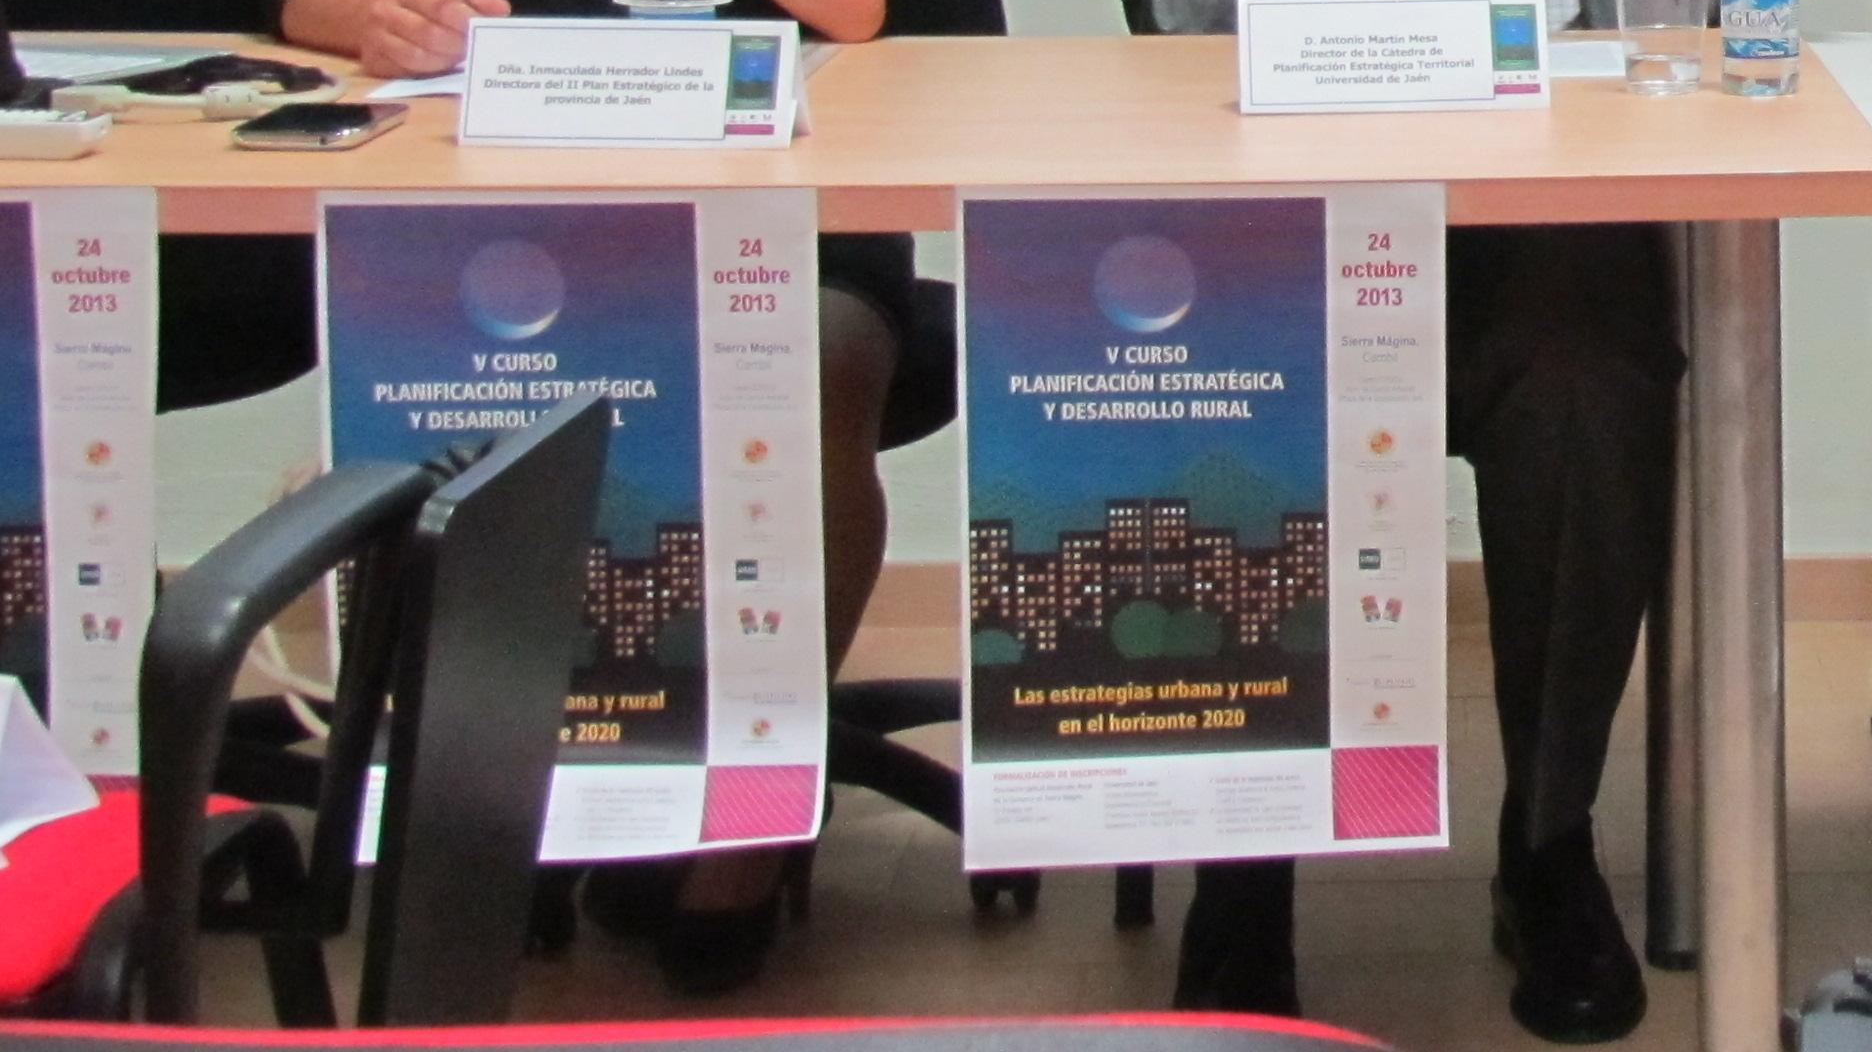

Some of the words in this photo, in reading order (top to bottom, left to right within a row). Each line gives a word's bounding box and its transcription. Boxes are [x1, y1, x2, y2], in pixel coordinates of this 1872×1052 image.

[1304, 37, 1316, 46] D.
[1320, 36, 1364, 45] Antonio
[1409, 35, 1438, 43] Mesa
[1301, 49, 1347, 59] Director
[1351, 49, 1364, 58] de
[1368, 49, 1378, 57] la
[1430, 47, 1443, 56] de
[498, 64, 526, 75] Dña.
[530, 65, 602, 76] Inmaculada
[606, 67, 660, 76] Herrador
[664, 67, 703, 77] Lindes
[1273, 62, 1346, 72] Planificación
[1417, 59, 1475, 69] Territorial
[484, 79, 541, 89] Directora
[544, 80, 563, 90] del
[567, 80, 578, 90] II
[583, 80, 609, 90] Plan
[685, 82, 699, 91] de
[703, 82, 714, 91] la
[1315, 75, 1383, 85] Universidad
[1387, 75, 1400, 83] de
[1404, 73, 1430, 83] Jaén
[545, 94, 600, 106] provincia
[605, 95, 619, 105] de
[77, 239, 101, 256] 24
[740, 239, 763, 256] 24
[1368, 233, 1391, 251] 24
[52, 267, 130, 284] octubre
[714, 266, 790, 284] octubre
[1342, 261, 1417, 277] octubre
[68, 295, 117, 312] 2013
[730, 294, 776, 312] 2013
[1357, 288, 1402, 305] 2013
[1341, 336, 1373, 347] Sierra
[472, 354, 486, 372] V
[493, 353, 558, 372] CURSO
[1107, 346, 1118, 364] V
[1124, 346, 1188, 364] CURSO
[376, 378, 524, 401] PLANIFICACIÓN
[1010, 370, 1154, 394] PLANIFICACIÓN
[1160, 368, 1284, 392] ESTRATÉGICA
[1044, 403, 1056, 420] Y
[1062, 401, 1185, 420] DESARROLLO
[1190, 400, 1252, 418] RURAL
[409, 412, 422, 430] Y
[1014, 688, 1045, 705] Las
[1050, 682, 1153, 705] estrategias
[1159, 680, 1222, 698] urbana
[1228, 682, 1239, 700] y
[1244, 677, 1288, 696] rural
[604, 695, 615, 714] y
[620, 691, 665, 710] rural
[1059, 717, 1081, 735] en
[1087, 714, 1103, 732] el
[1109, 712, 1196, 731] horizonte
[1202, 709, 1245, 728] 2020
[576, 723, 621, 741] 2020
